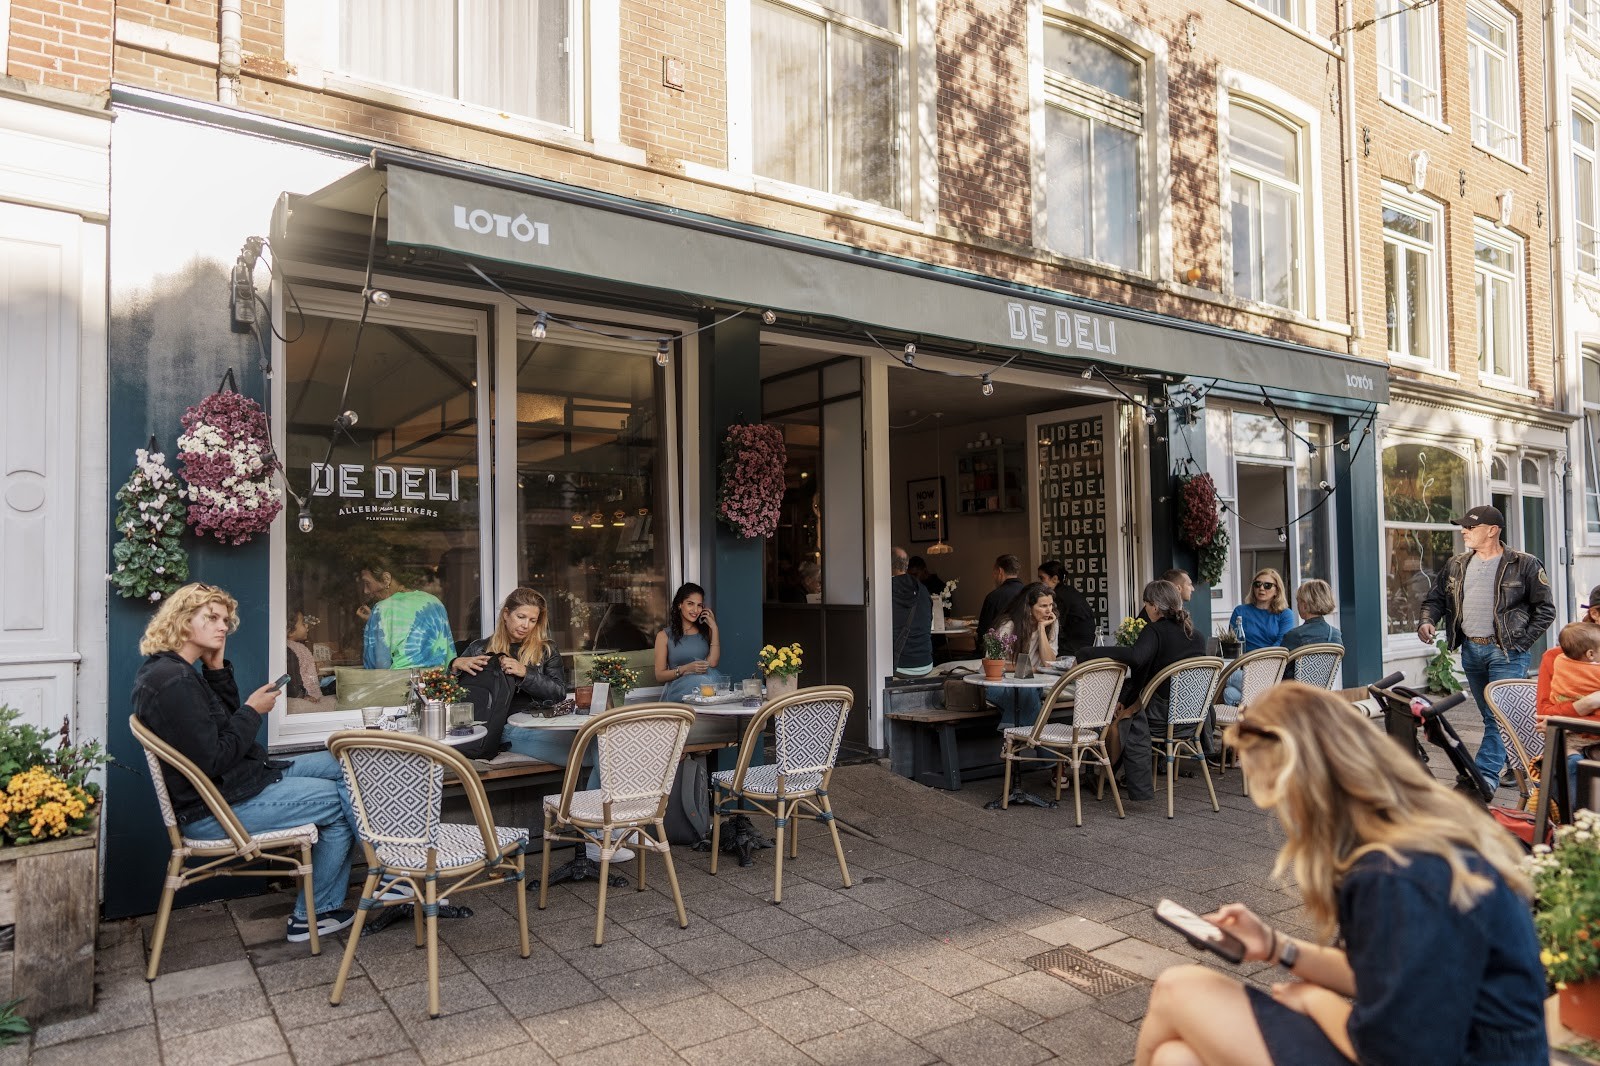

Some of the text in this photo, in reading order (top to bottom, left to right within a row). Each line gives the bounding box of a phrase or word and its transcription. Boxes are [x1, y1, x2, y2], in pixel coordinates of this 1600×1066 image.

[1008, 302, 1116, 355] DE DELI
[310, 462, 459, 501] DE DELI
[916, 489, 935, 500] NOW
[338, 505, 378, 516] ALLEEN
[393, 505, 439, 518] LEKKERS
[917, 501, 925, 510] IS
[918, 520, 937, 530] TIME
